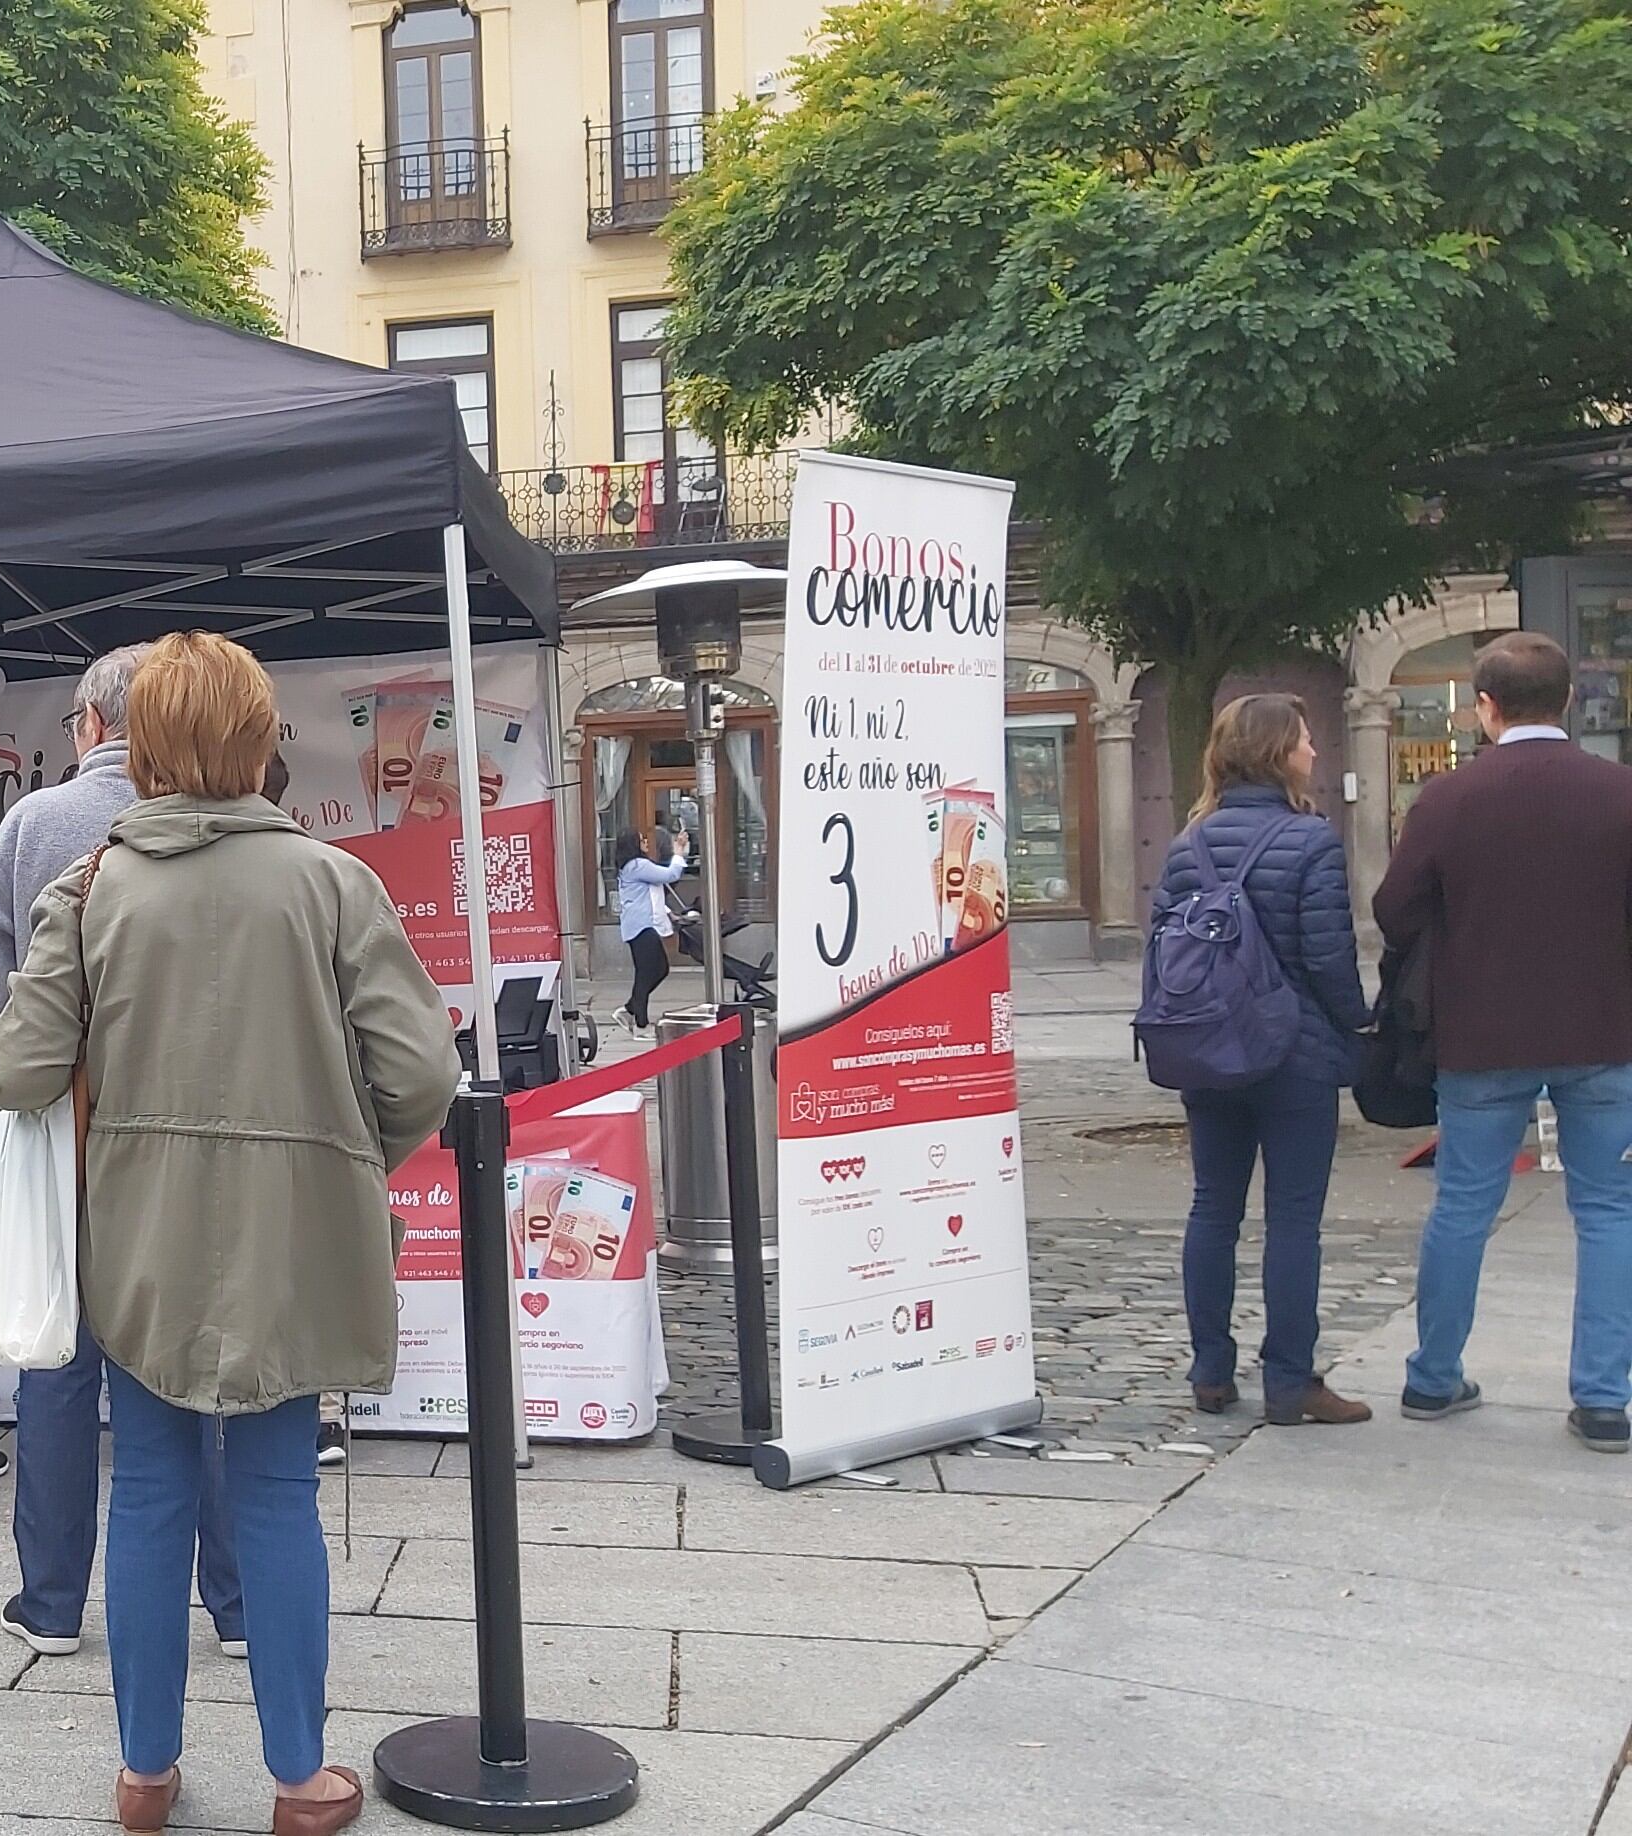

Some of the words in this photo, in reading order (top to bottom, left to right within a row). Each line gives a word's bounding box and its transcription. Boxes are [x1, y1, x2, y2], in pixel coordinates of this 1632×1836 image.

[824, 501, 965, 581] Bonos
[806, 564, 1002, 637] comercio
[818, 652, 840, 671] del
[855, 654, 865, 672] al
[868, 655, 881, 673] 31
[884, 655, 897, 673] de
[901, 657, 955, 675] octubre
[959, 658, 972, 676] de
[805, 695, 841, 739] Ni
[867, 703, 888, 739] ni
[383, 757, 413, 793] 10
[804, 747, 852, 790] este
[860, 757, 899, 790] año
[906, 762, 946, 791] son
[815, 813, 858, 967] 3
[947, 867, 965, 903] 10
[436, 930, 468, 939] usuarios
[839, 964, 882, 1005] bonos
[889, 945, 909, 977] de
[388, 1190, 422, 1207] nos
[428, 1183, 453, 1205] de
[529, 1215, 552, 1242] 10
[593, 1233, 620, 1261] 10
[519, 1329, 547, 1338] ompra
[435, 1397, 467, 1414] fes
[524, 1402, 557, 1416] COO
